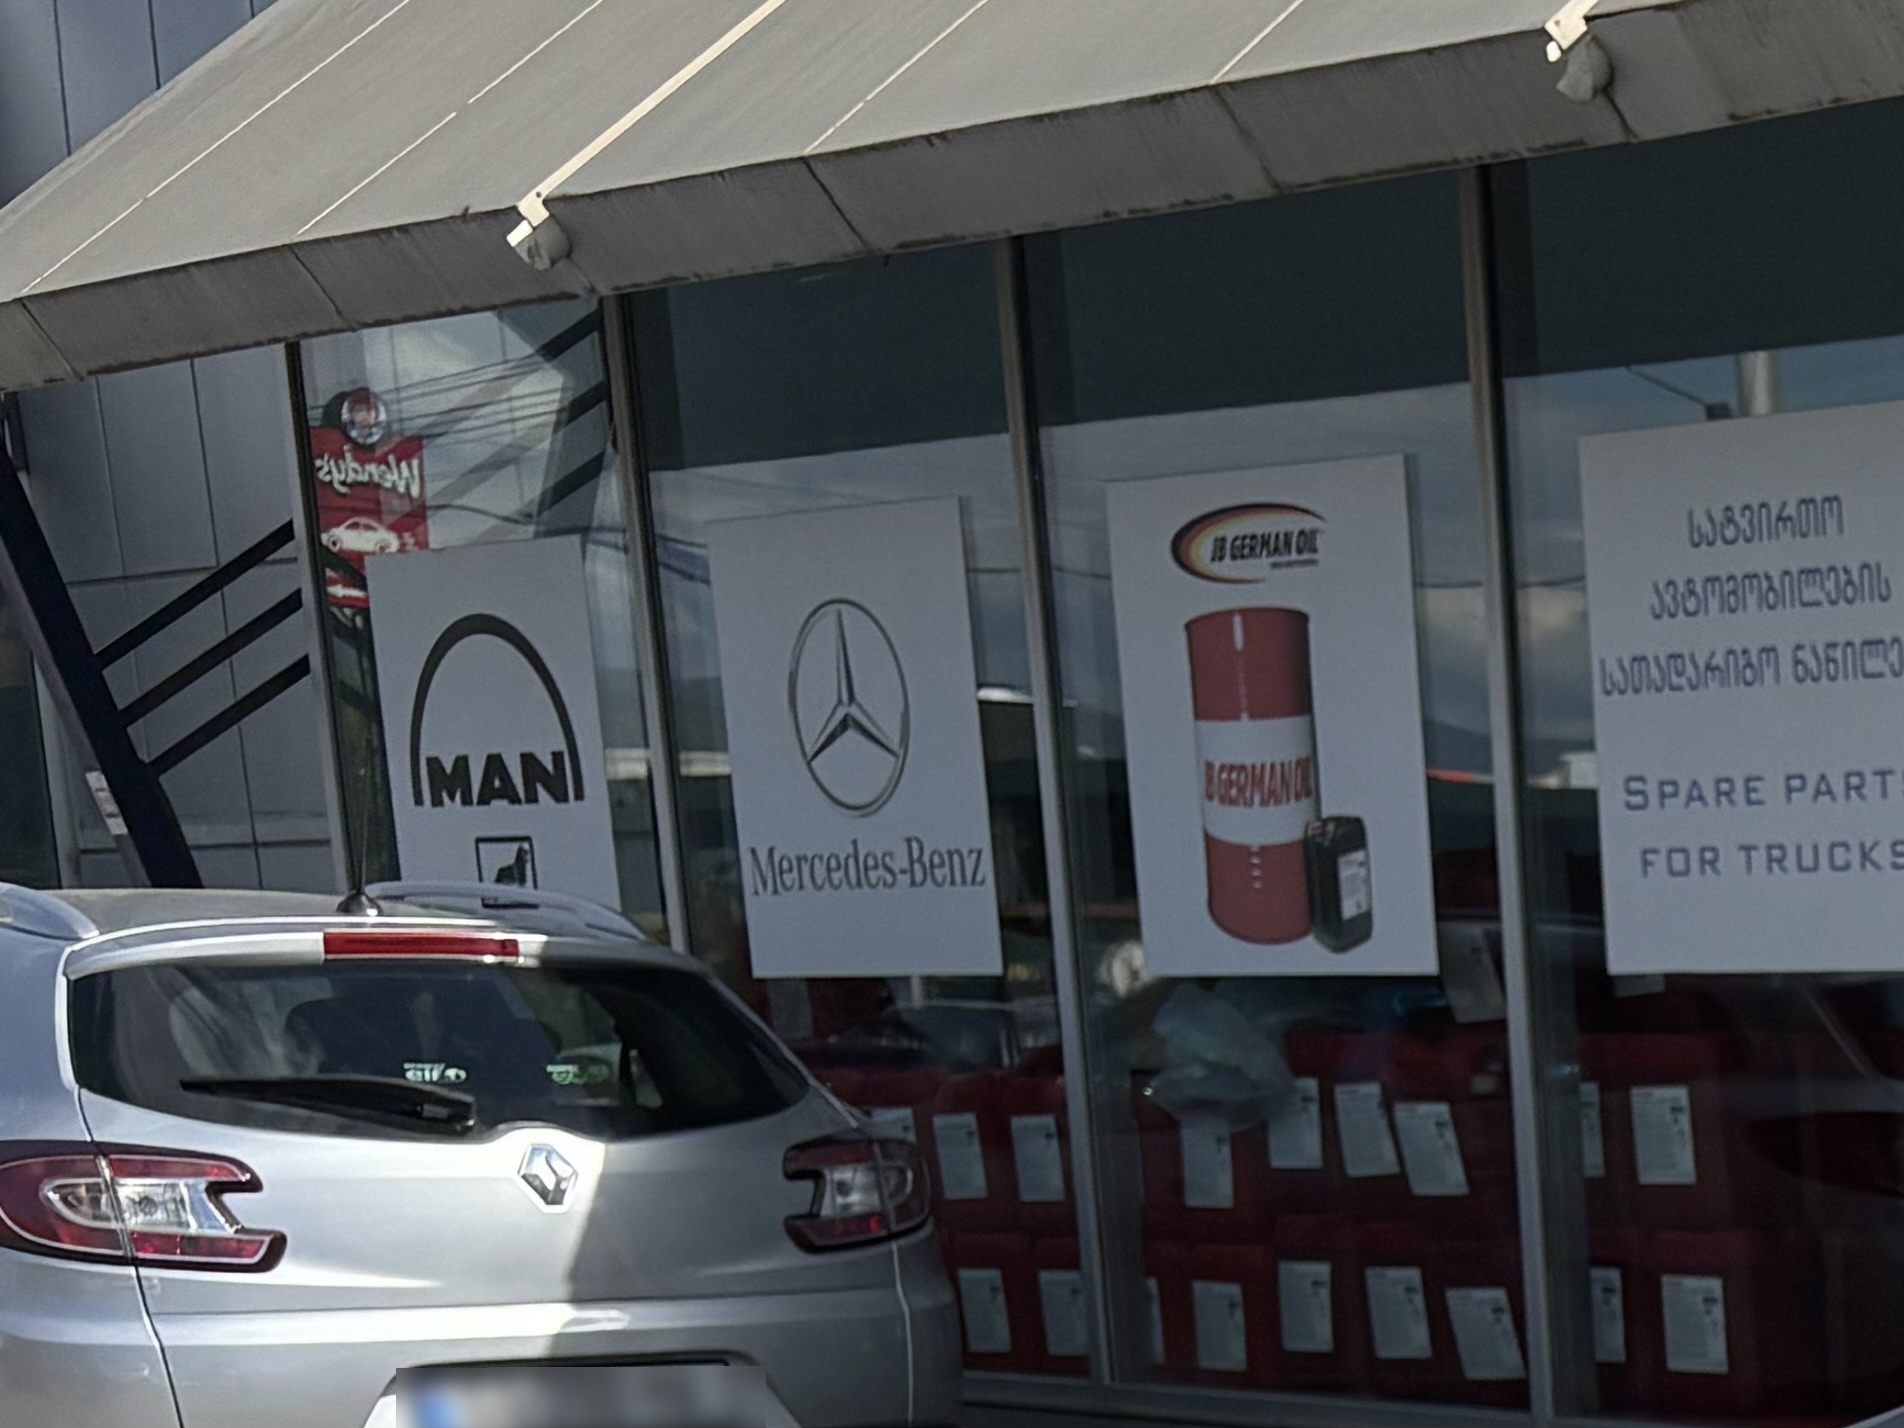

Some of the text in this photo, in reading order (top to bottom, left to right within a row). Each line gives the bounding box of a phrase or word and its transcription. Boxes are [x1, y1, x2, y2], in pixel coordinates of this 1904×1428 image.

[1230, 530, 1295, 561] GERMAN
[1687, 495, 1845, 548] სატვირთო
[1650, 561, 1892, 620] ავტომობილების
[1600, 645, 1781, 697] სათადარიგო
[425, 750, 570, 807] MAN
[1623, 775, 1766, 811] SPARE
[749, 835, 987, 897] Mercedes-Benz
[1640, 846, 1721, 878] FOR
